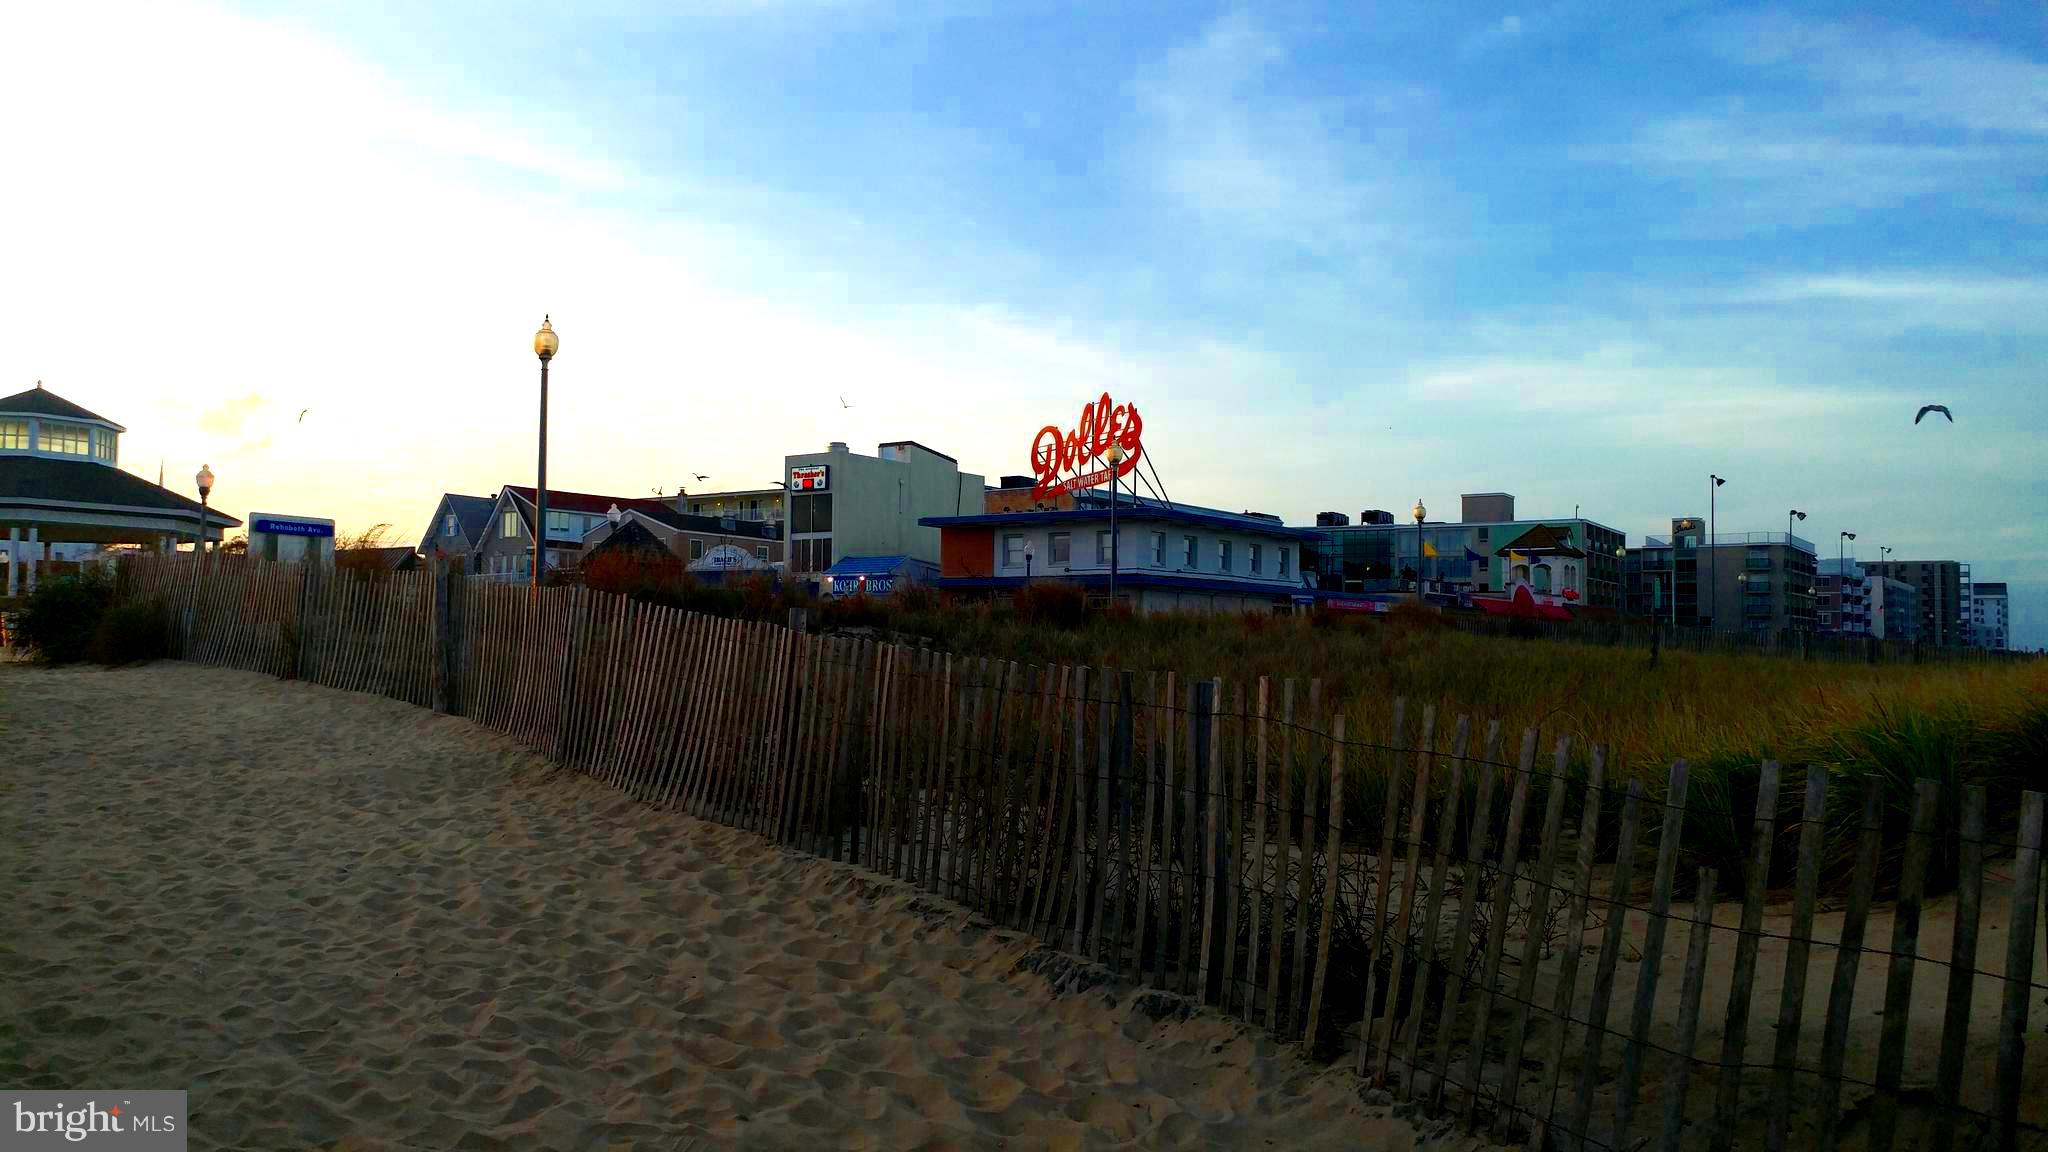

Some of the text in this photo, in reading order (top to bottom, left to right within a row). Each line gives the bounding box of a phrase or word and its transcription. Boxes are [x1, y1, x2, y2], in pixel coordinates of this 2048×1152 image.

[1031, 391, 1143, 501] Dolles
[1063, 479, 1077, 492] SALT
[1077, 474, 1099, 488] WATER
